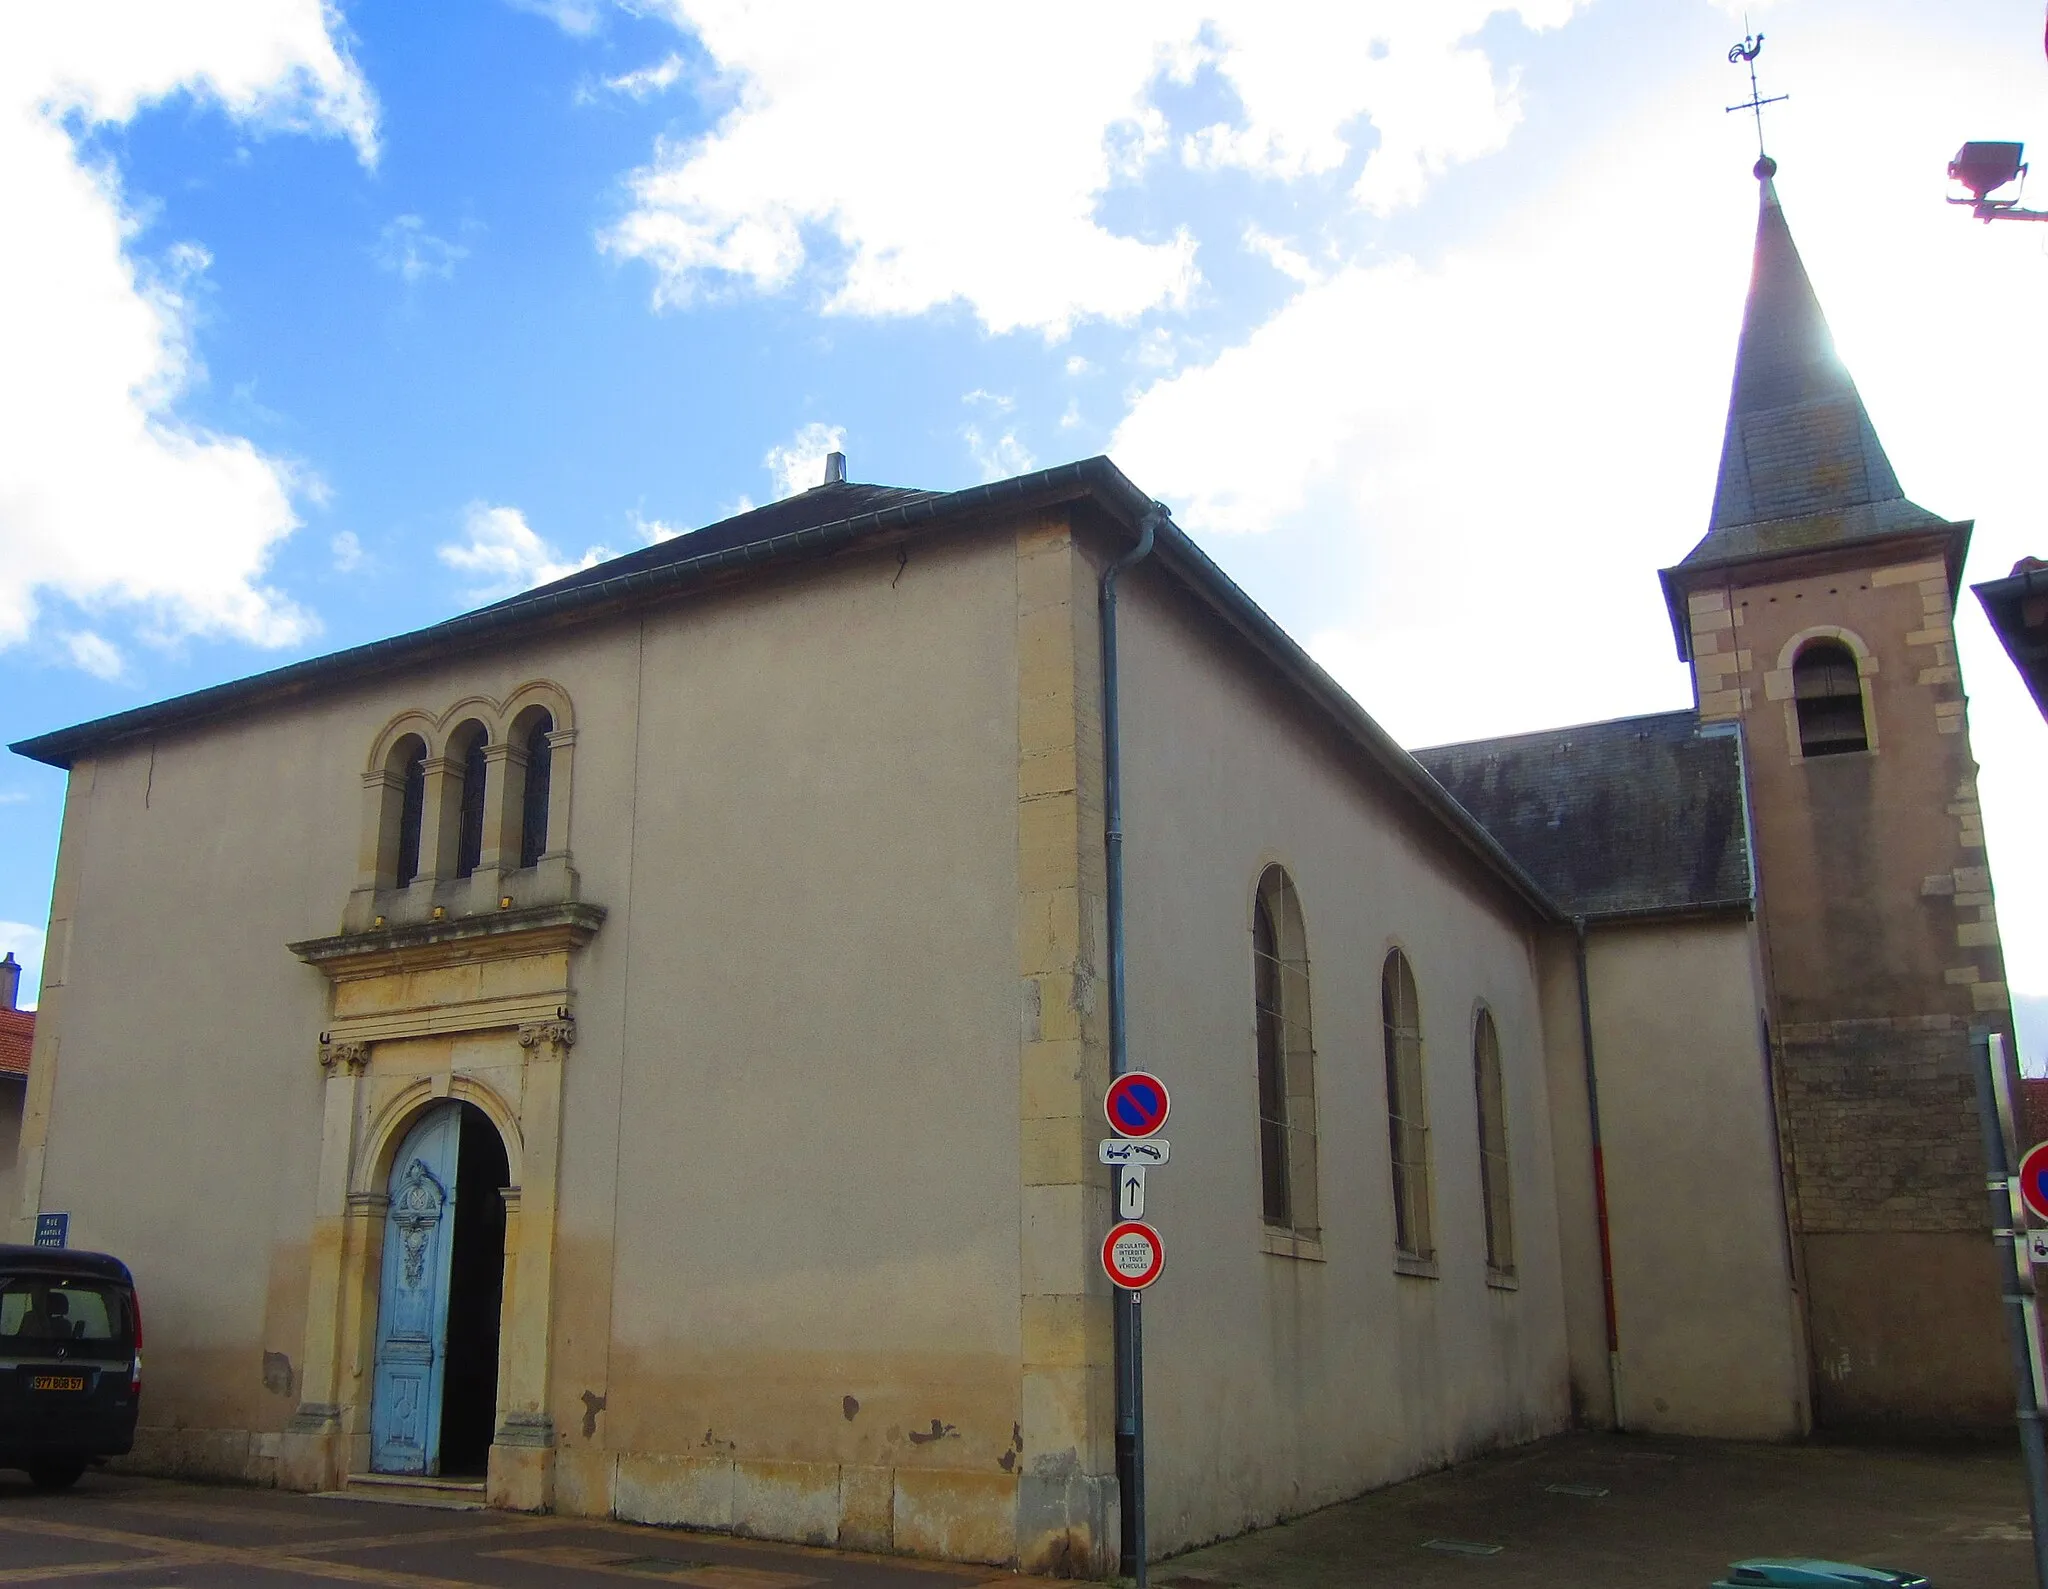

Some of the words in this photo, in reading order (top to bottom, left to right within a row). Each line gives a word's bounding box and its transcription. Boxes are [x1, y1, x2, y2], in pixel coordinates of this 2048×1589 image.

[46, 1218, 58, 1226] RUE
[36, 1376, 52, 1388] 977
[70, 1377, 81, 1389] 57
